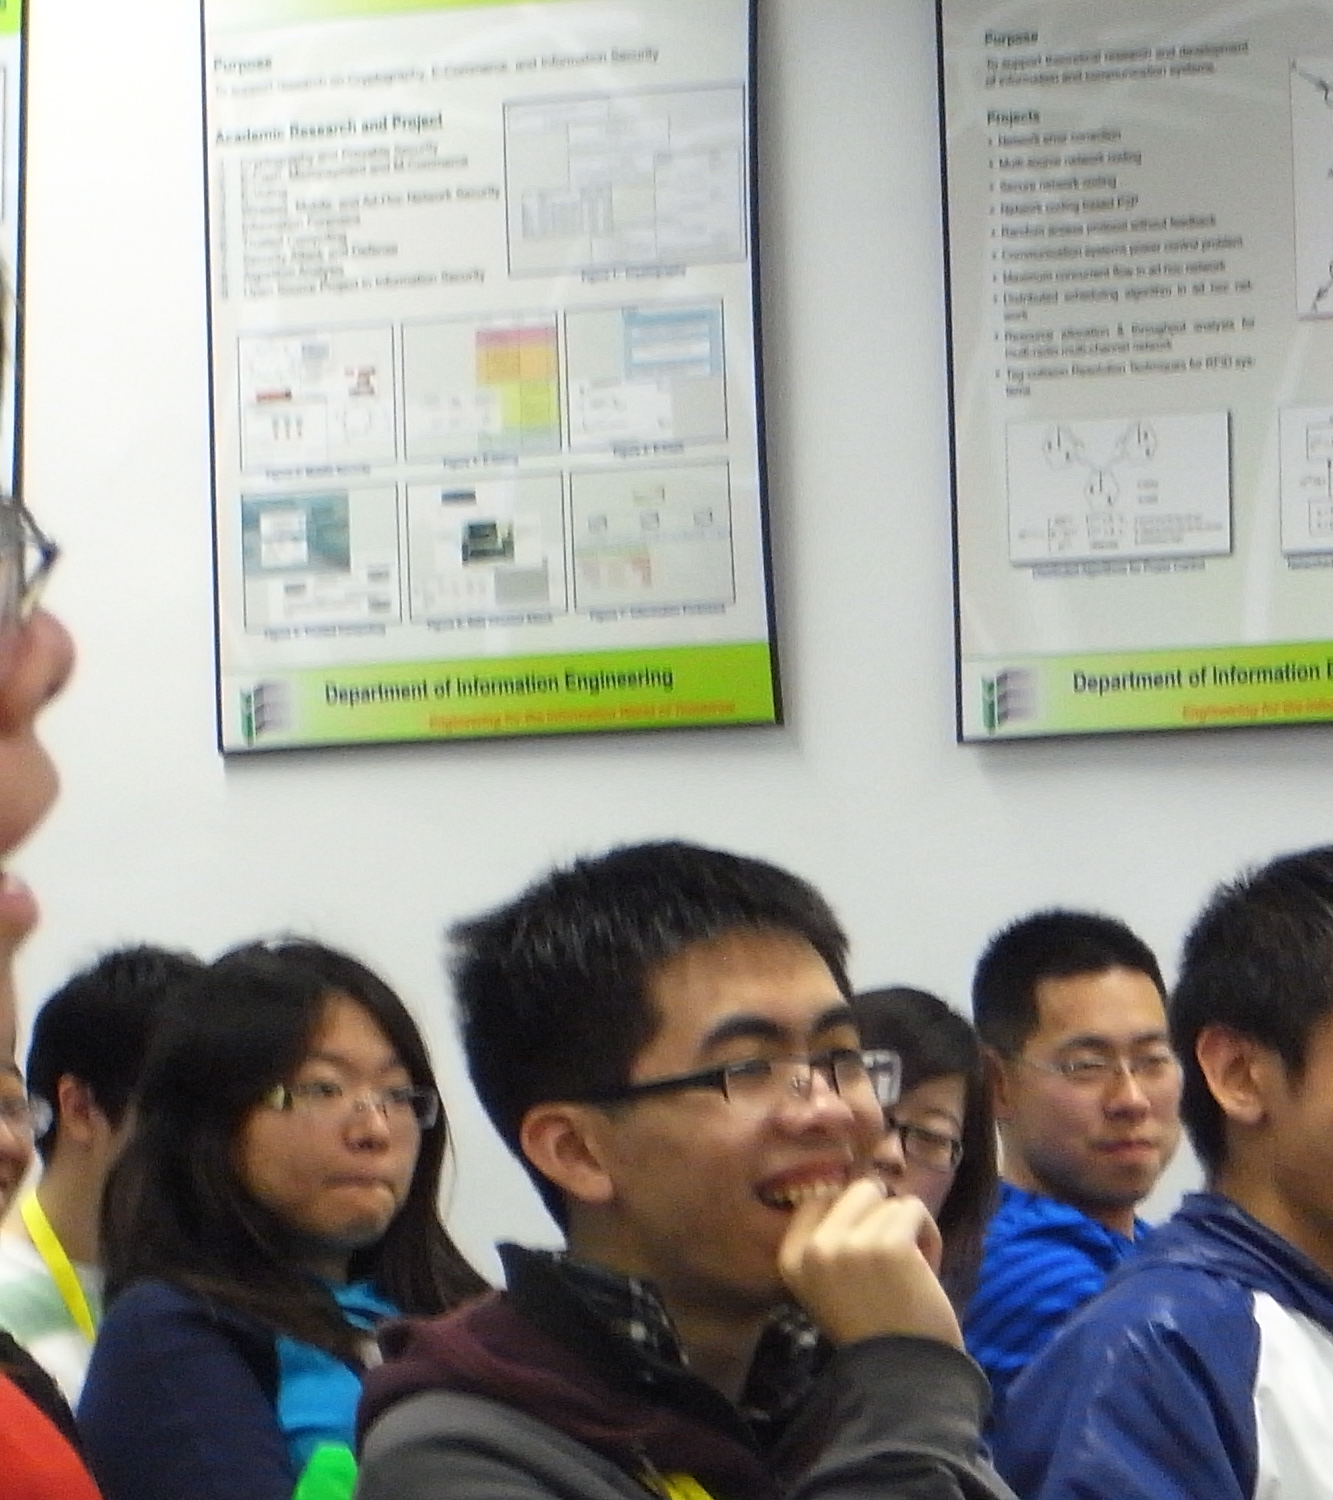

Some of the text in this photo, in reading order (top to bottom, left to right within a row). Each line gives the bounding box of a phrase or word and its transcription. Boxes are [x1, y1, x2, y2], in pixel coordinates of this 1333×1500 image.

[324, 670, 673, 707] Department of Information Engineering
[1072, 670, 1182, 696] Department
[1188, 667, 1206, 686] of
[1212, 663, 1320, 685] Information
